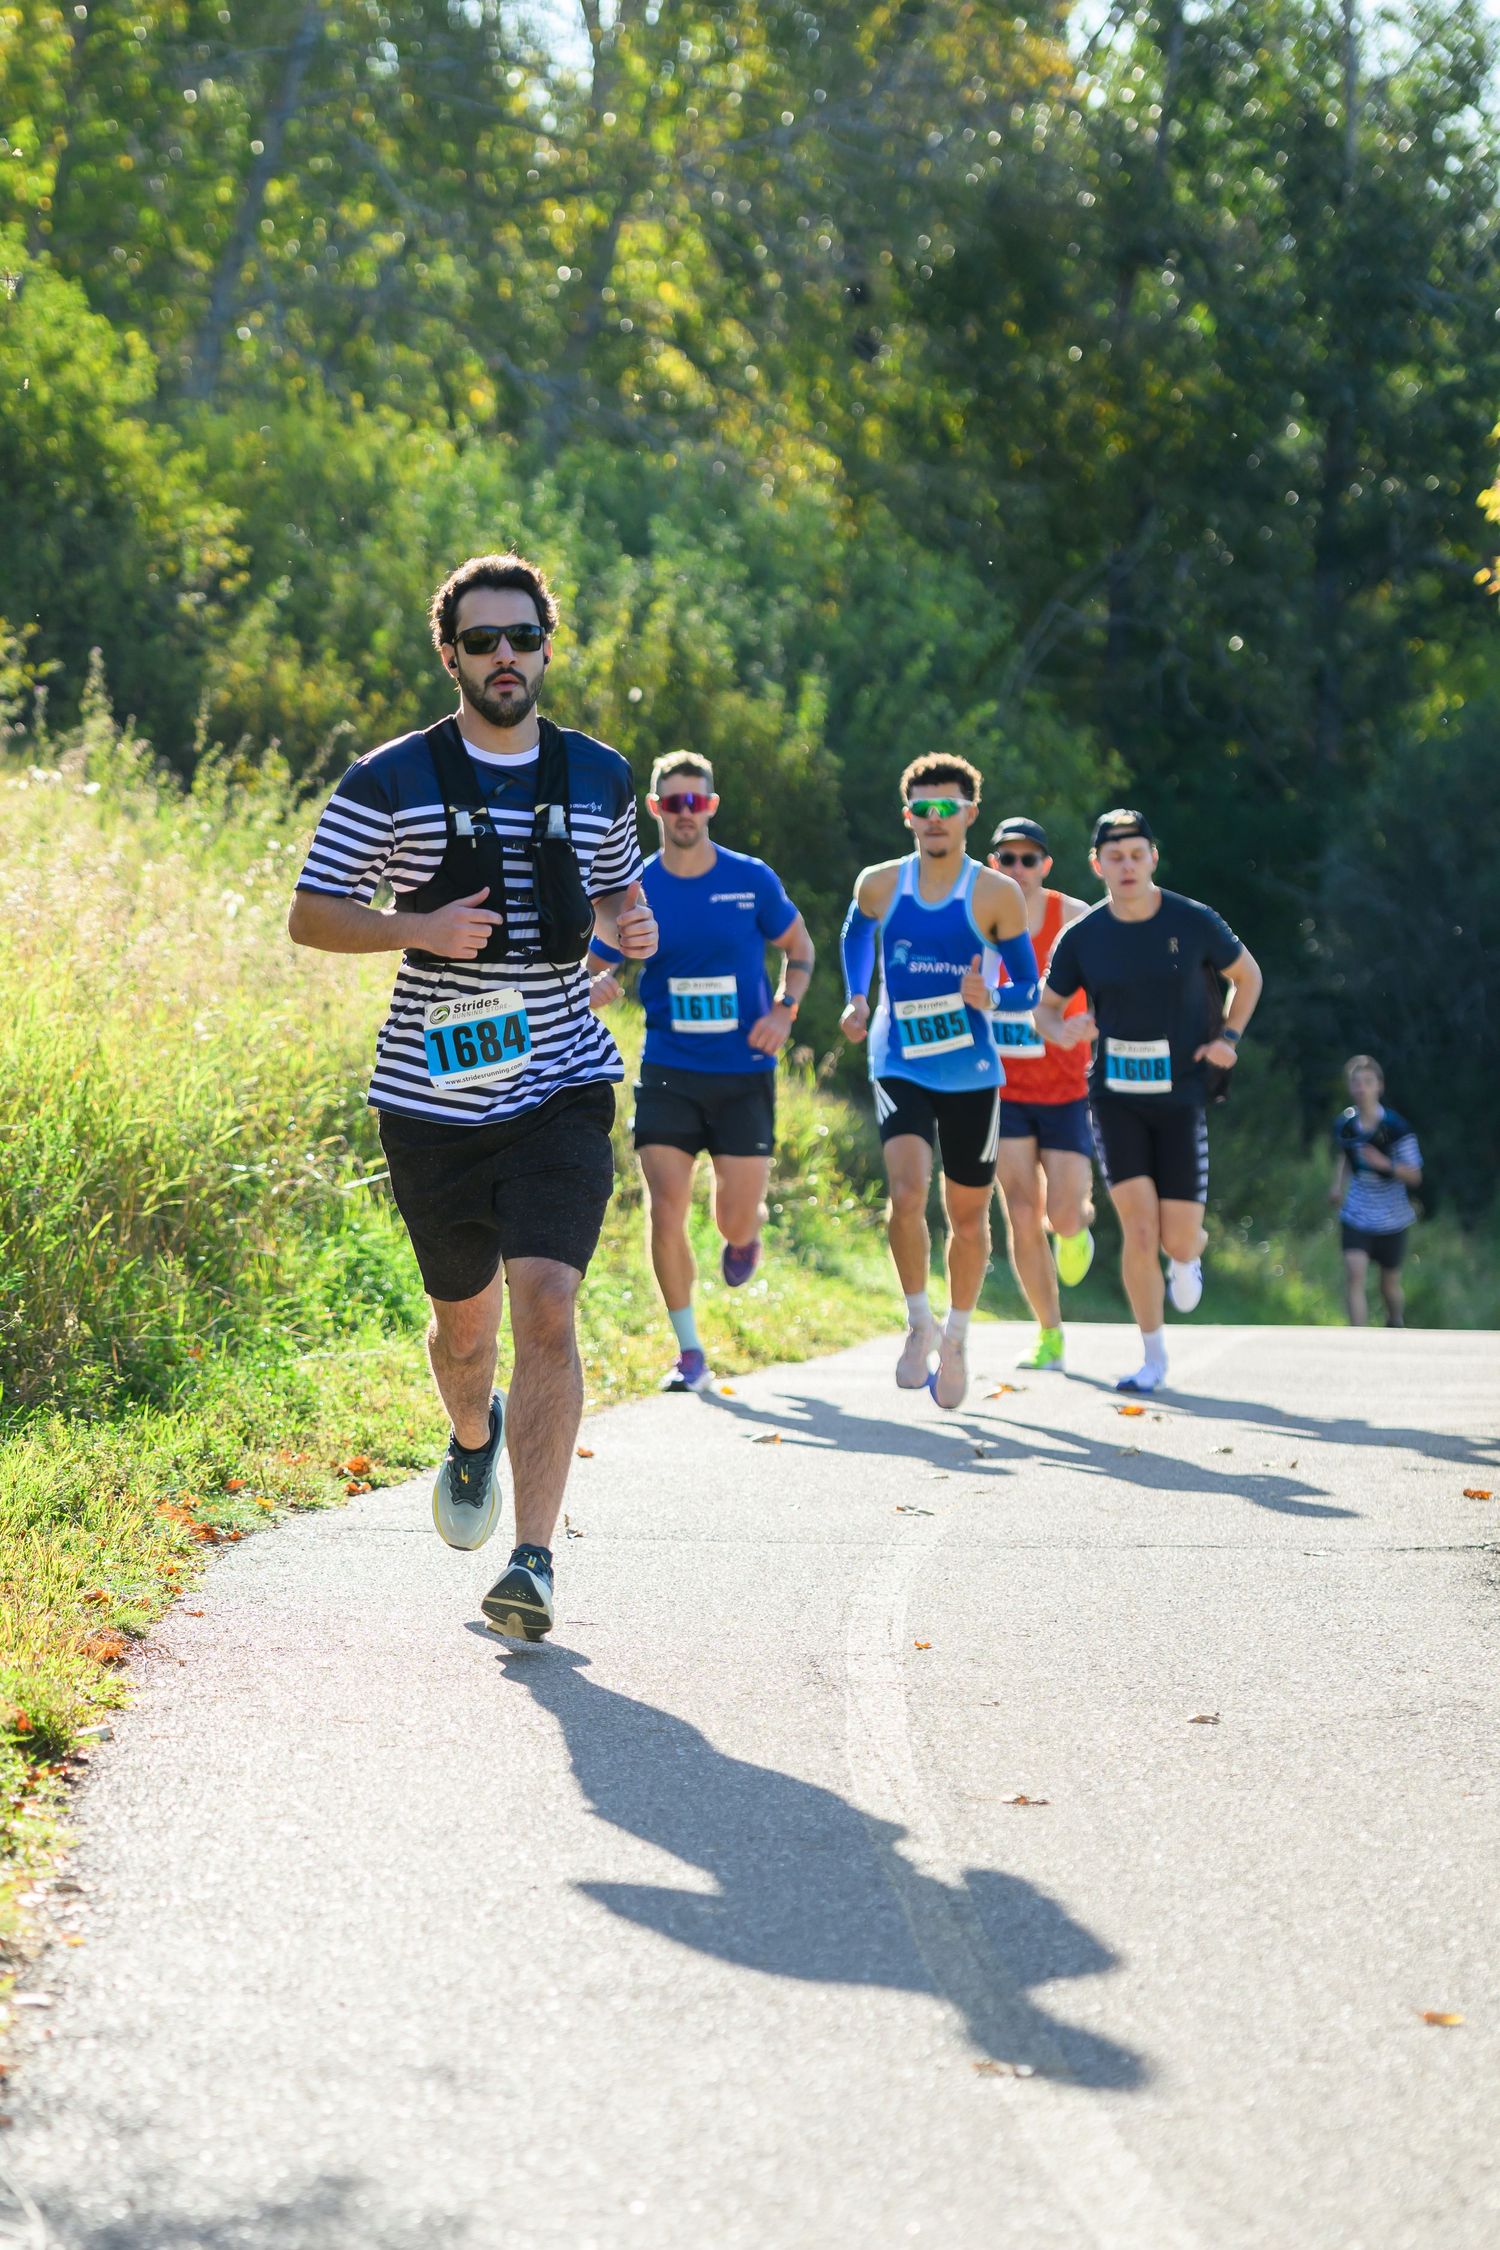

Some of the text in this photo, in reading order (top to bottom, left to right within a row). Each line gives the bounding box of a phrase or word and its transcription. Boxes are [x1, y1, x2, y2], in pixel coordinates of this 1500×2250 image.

[452, 1008, 483, 1020] RUNNING
[453, 997, 500, 1014] Strides
[676, 994, 733, 1020] 1616
[902, 1010, 965, 1046] 1685
[430, 1014, 526, 1072] 1684
[444, 1062, 523, 1086] www.stridesrunning.com
[1111, 1056, 1167, 1081] 1608
